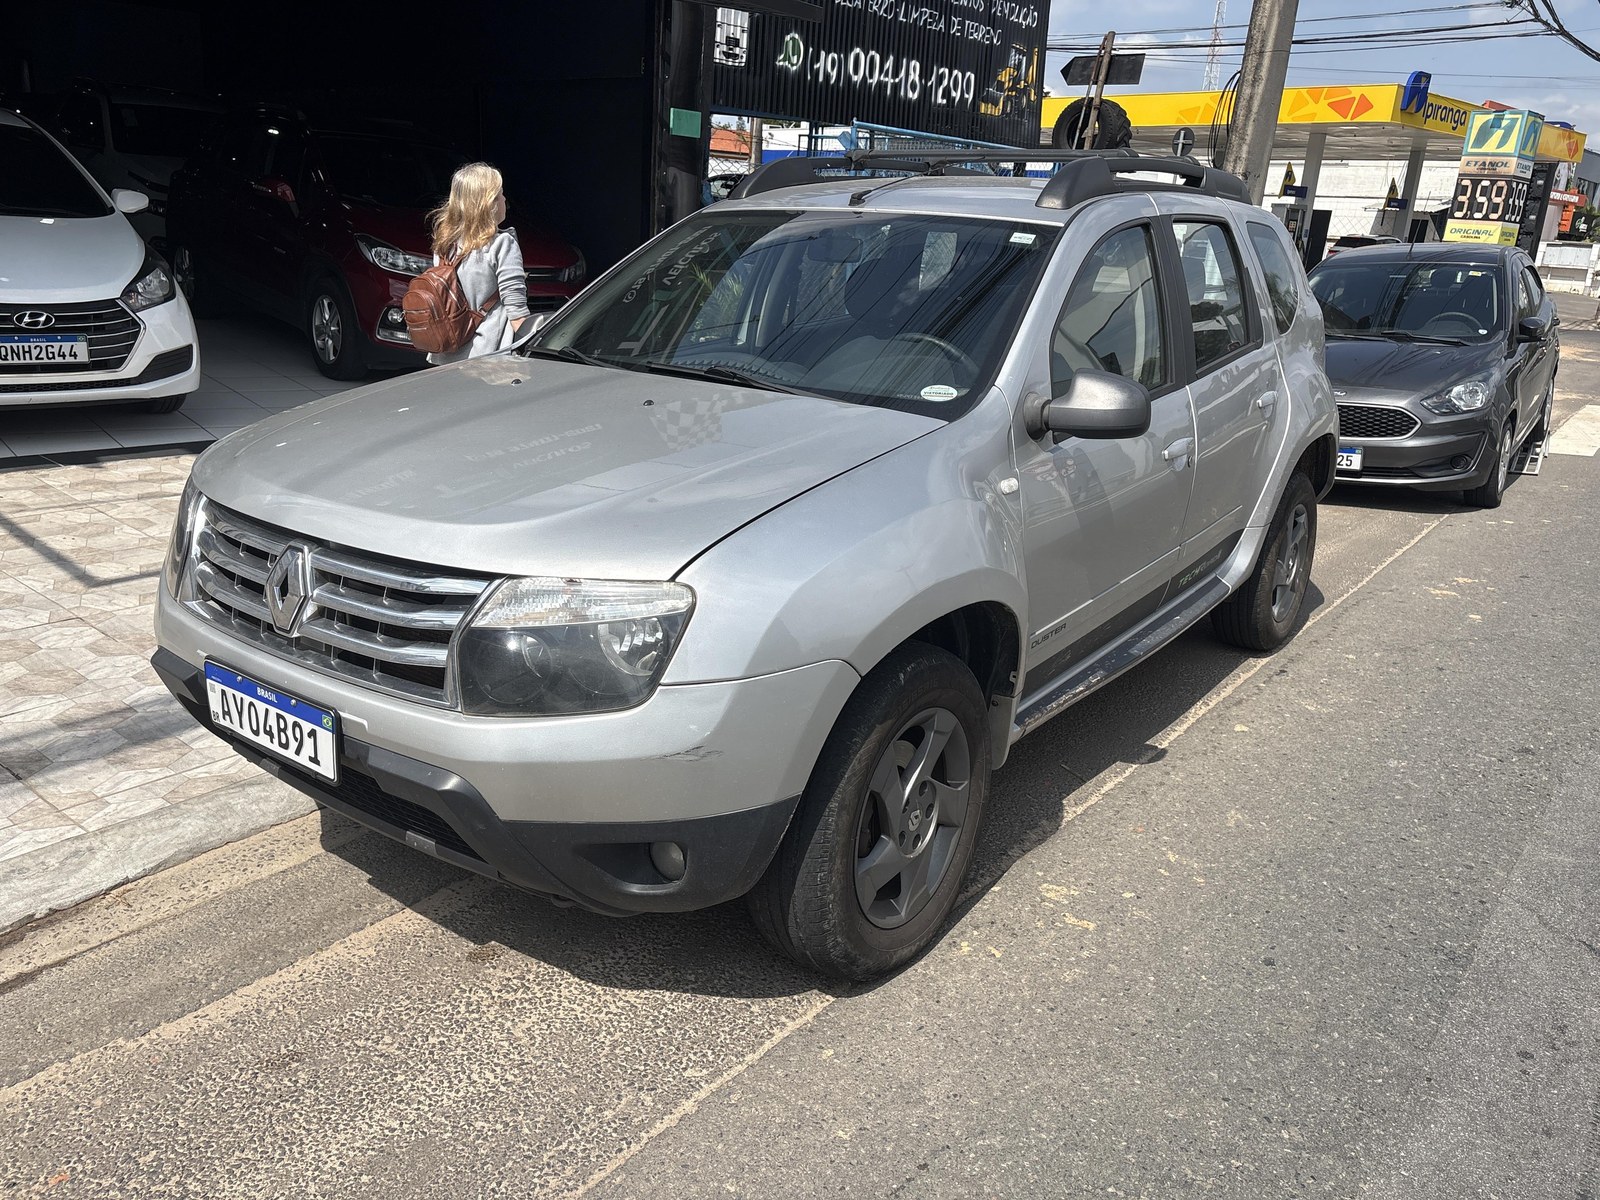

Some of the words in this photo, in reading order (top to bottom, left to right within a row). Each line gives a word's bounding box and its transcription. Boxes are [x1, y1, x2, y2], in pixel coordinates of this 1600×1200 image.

[899, 1, 945, 32] LIMPEZA
[950, 15, 962, 36] DE
[1465, 160, 1511, 168] ETANOL
[1453, 179, 1508, 220] 3,59
[1449, 227, 1494, 237] ORIGINAL
[0, 344, 78, 361] QNH2G44
[1030, 622, 1067, 649] DUSTER
[256, 686, 278, 703] BRASIL
[212, 709, 220, 722] BR
